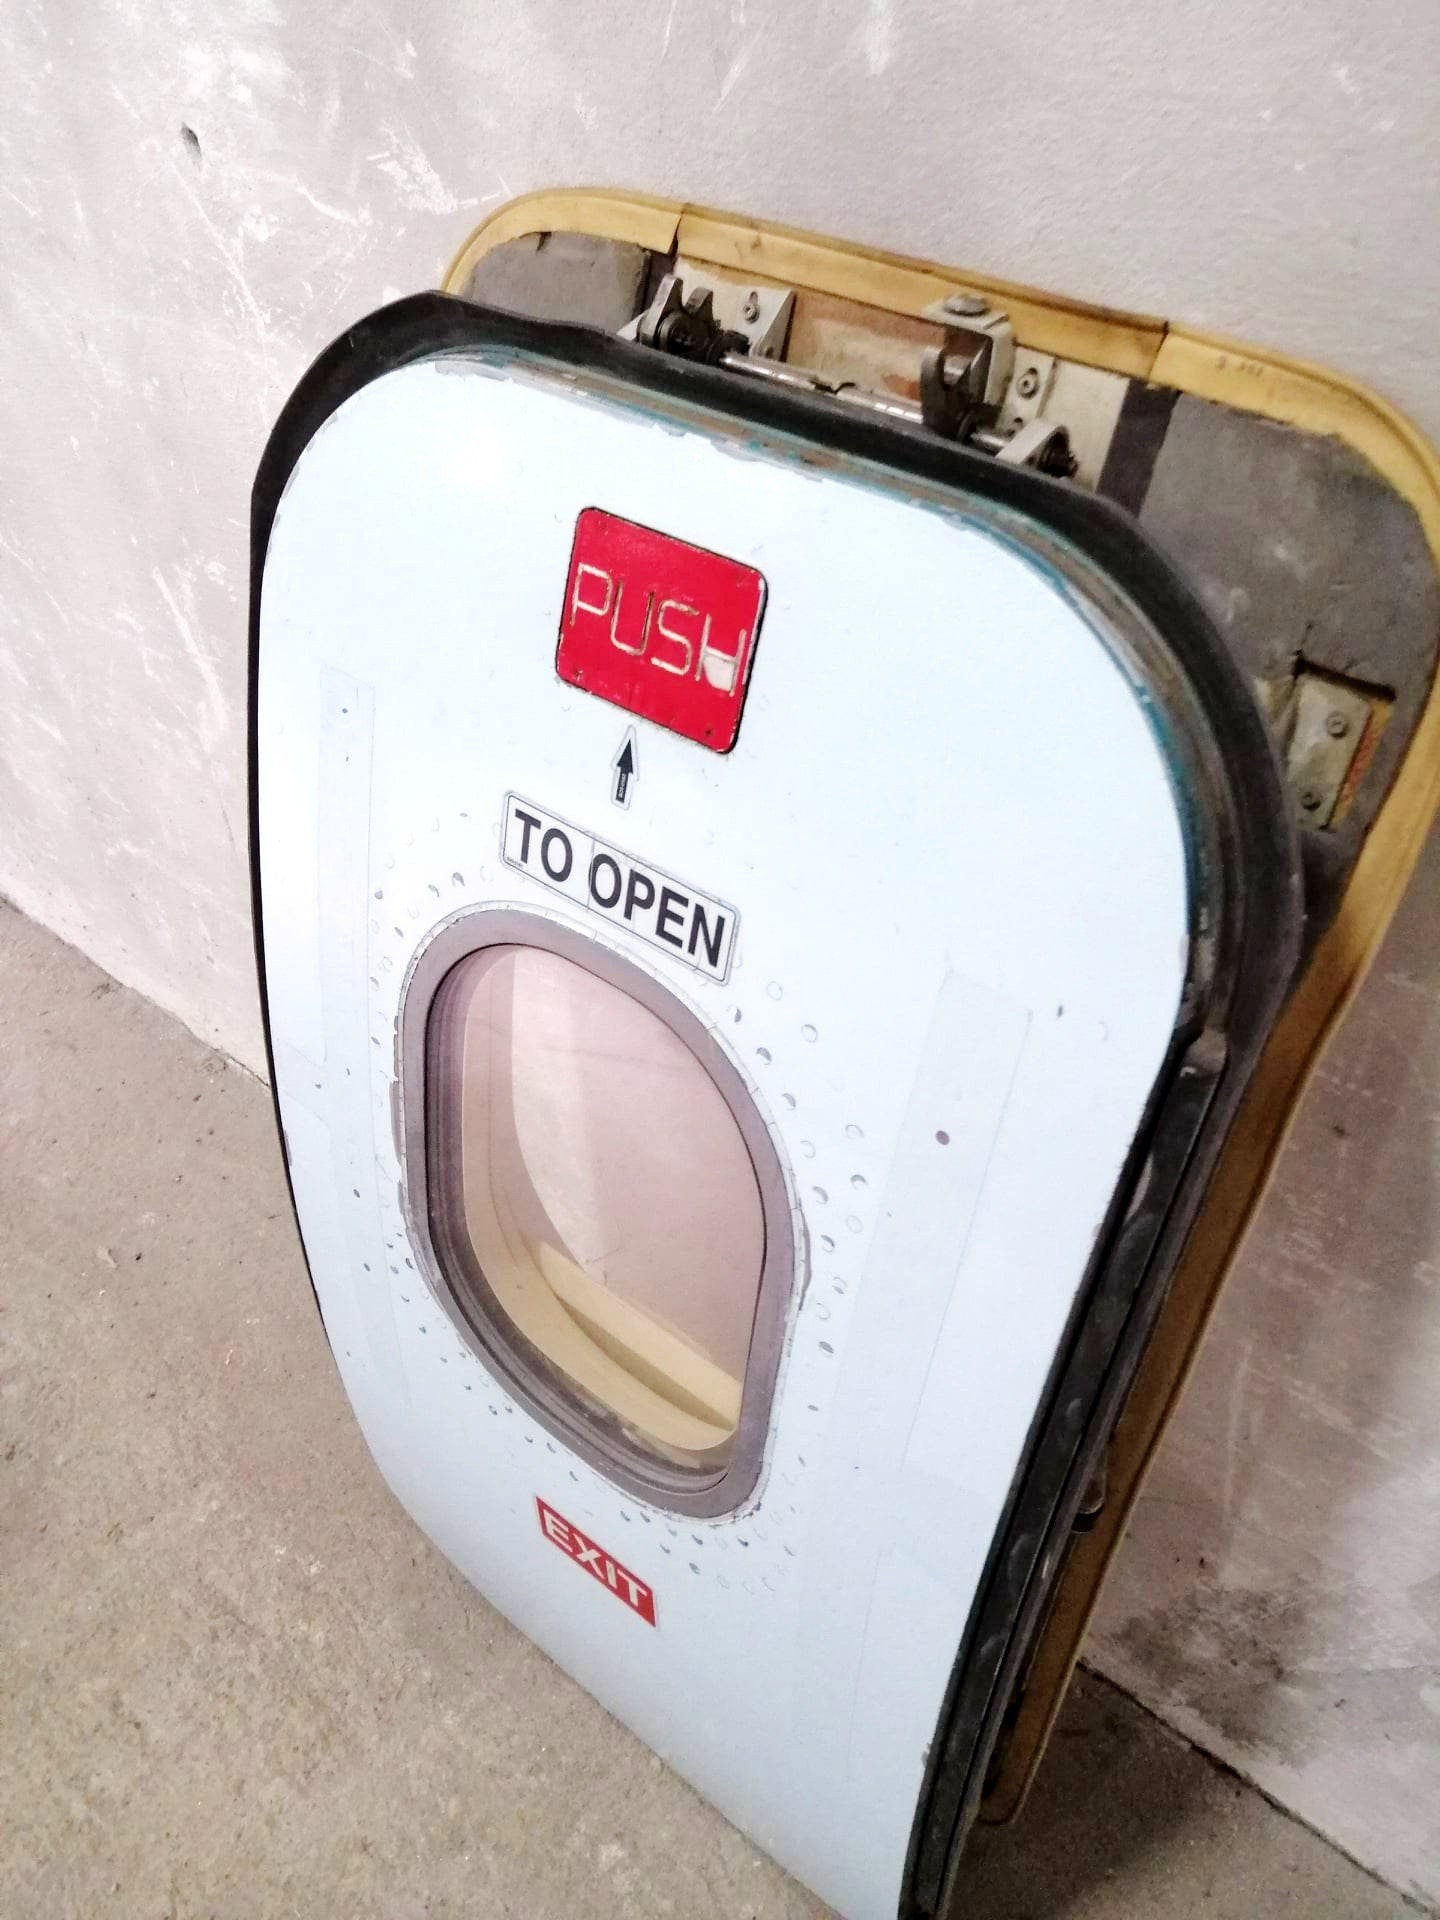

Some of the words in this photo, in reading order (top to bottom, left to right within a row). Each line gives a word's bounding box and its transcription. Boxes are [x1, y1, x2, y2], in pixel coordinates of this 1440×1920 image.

[569, 563, 747, 697] PUSH
[515, 808, 573, 882] TO
[589, 853, 725, 967] OPEN
[543, 1509, 648, 1607] EXIT
